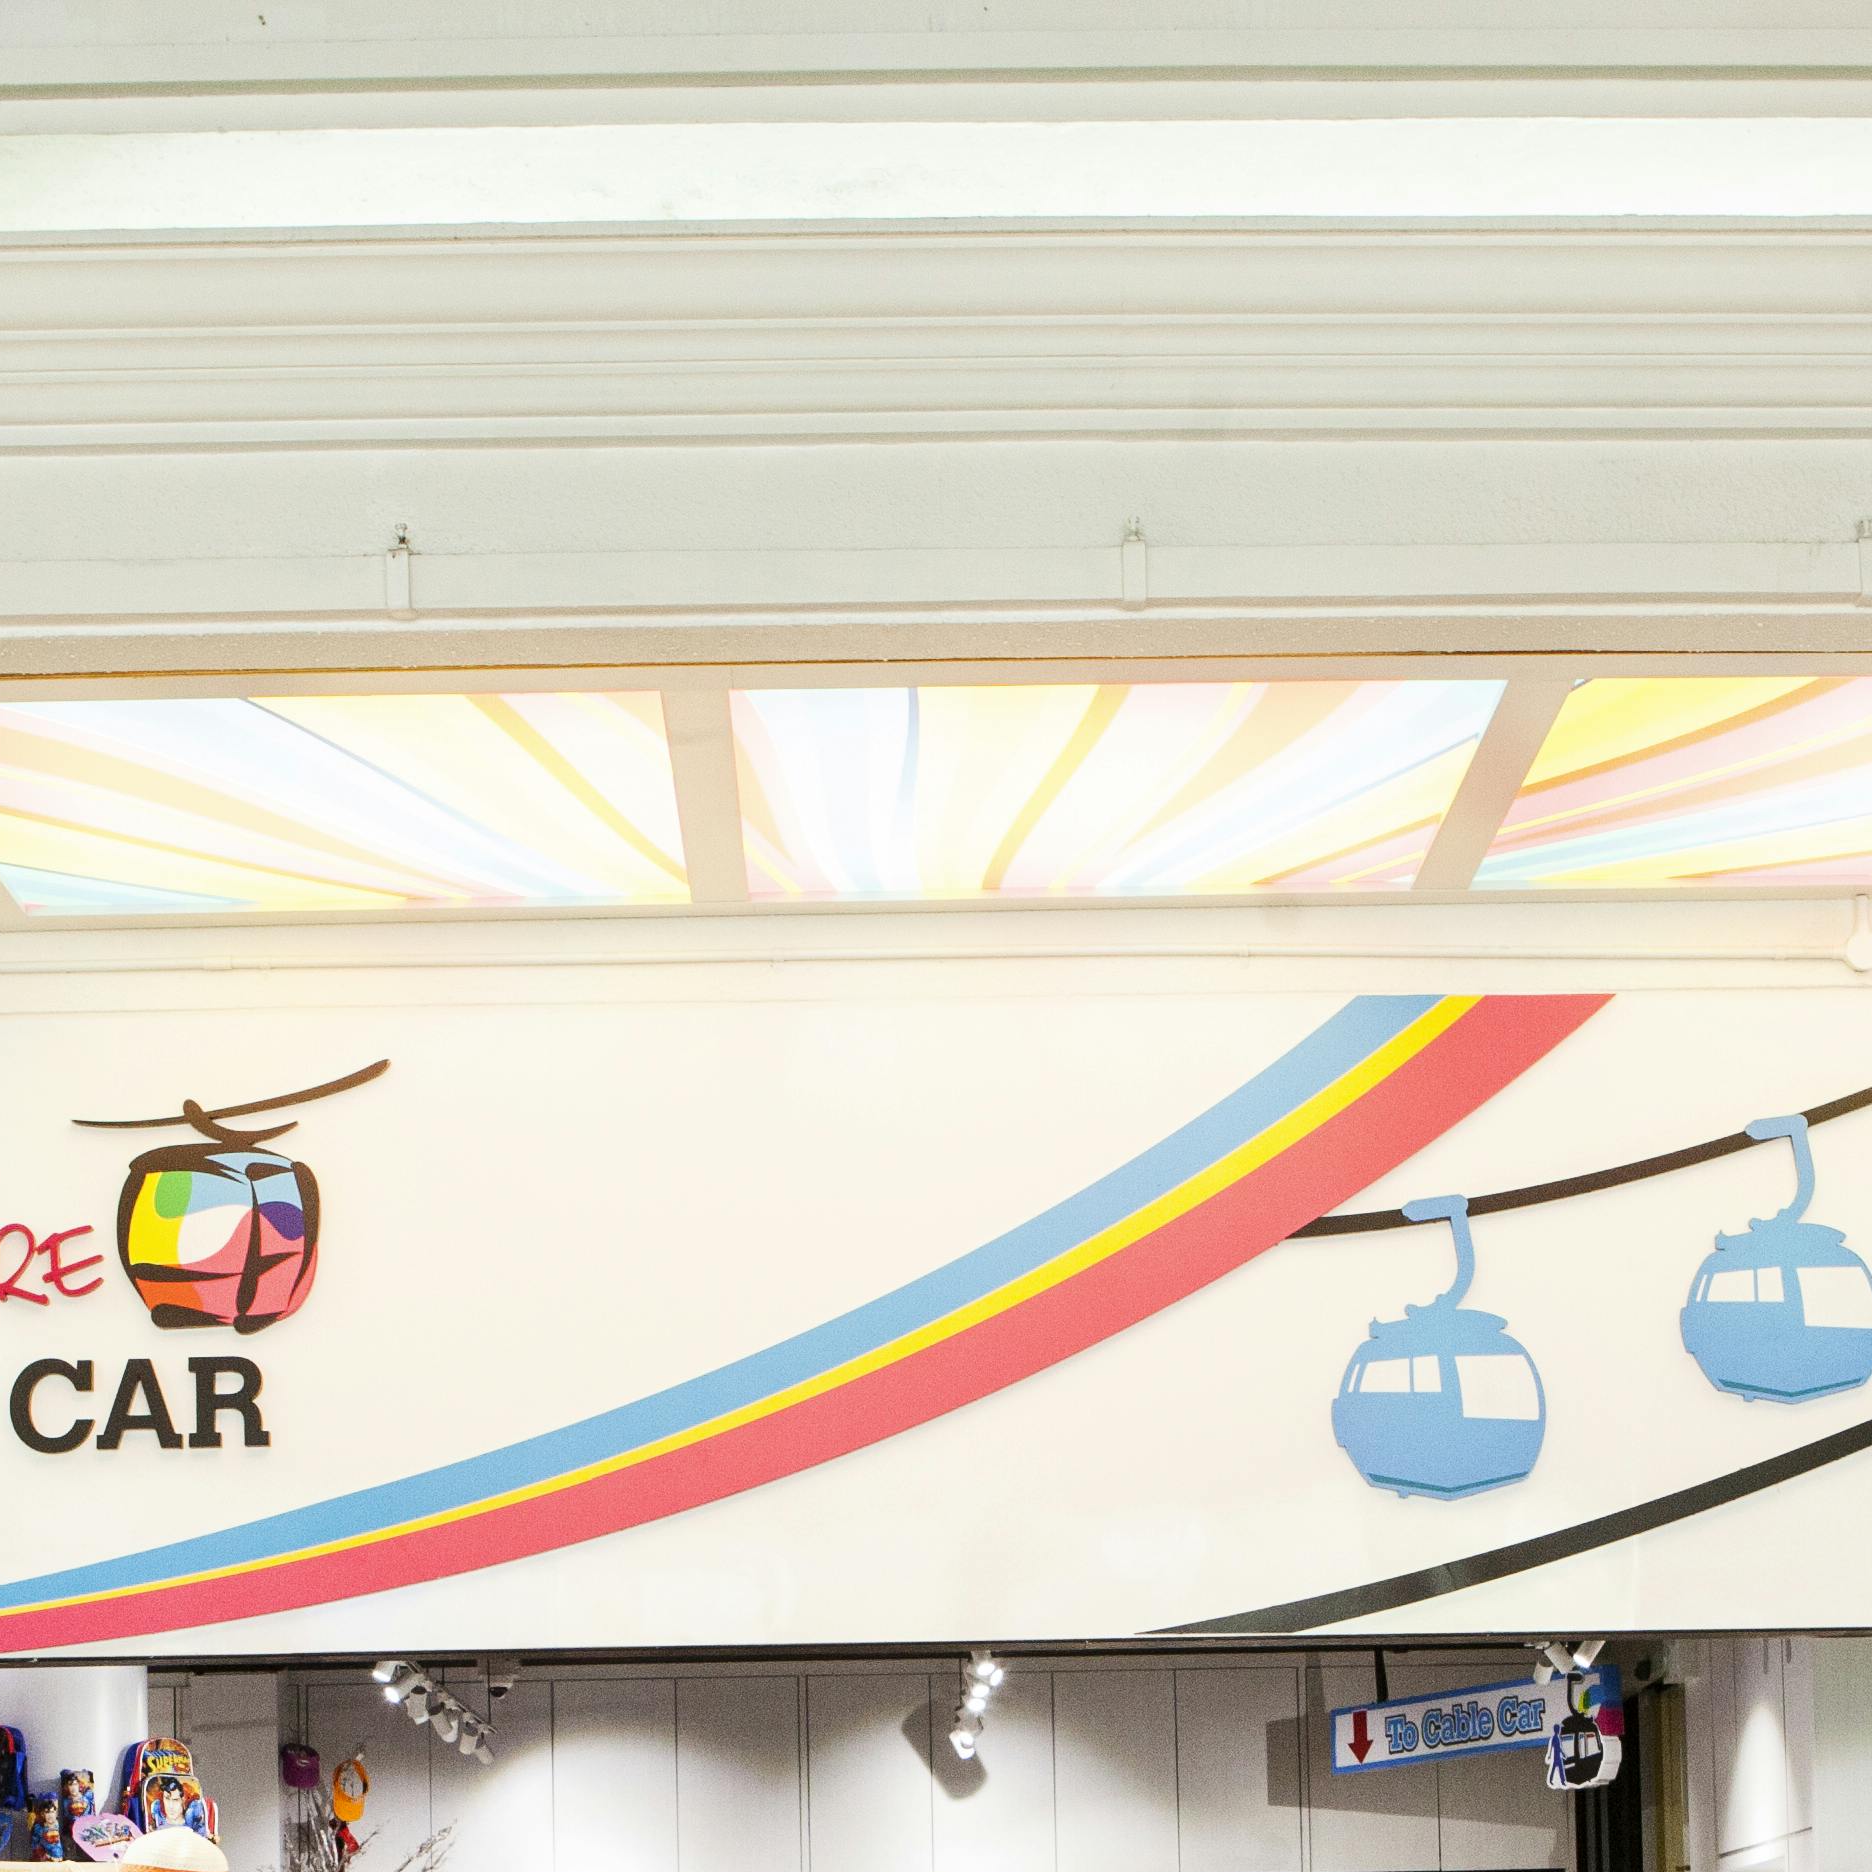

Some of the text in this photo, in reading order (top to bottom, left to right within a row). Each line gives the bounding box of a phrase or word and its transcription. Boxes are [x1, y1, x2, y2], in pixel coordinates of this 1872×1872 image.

[9, 1355, 270, 1453] CAR
[1386, 1696, 1546, 1752] To Cable Car
